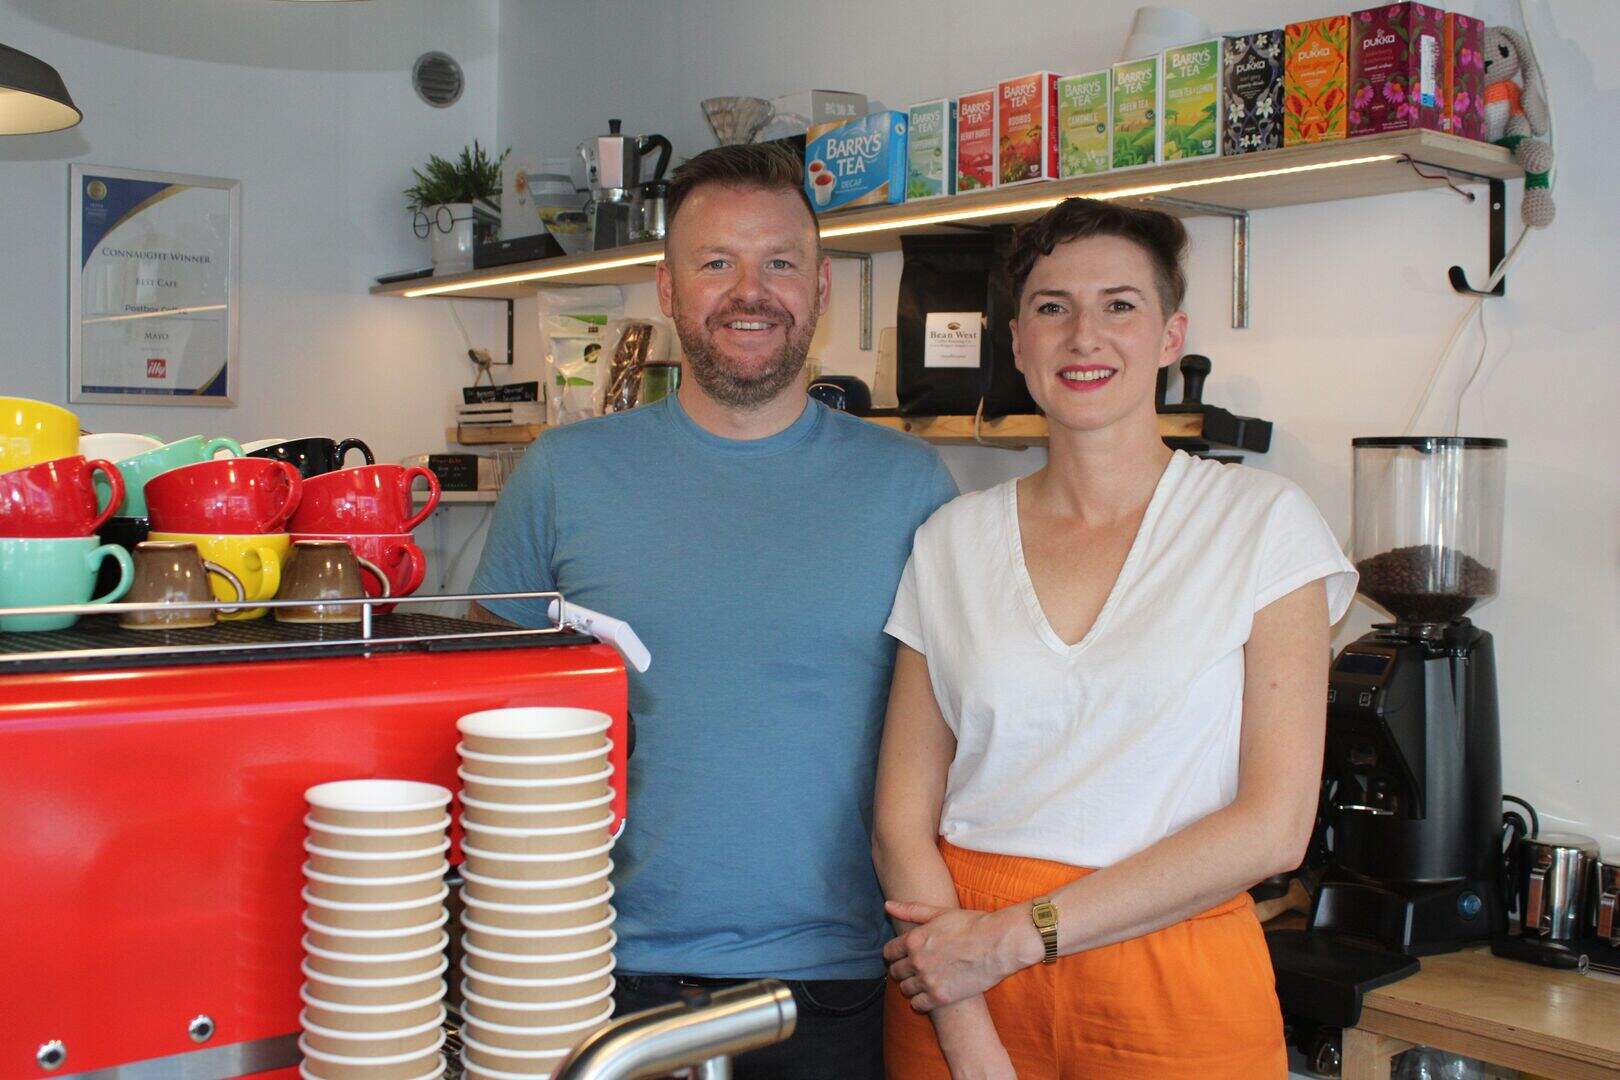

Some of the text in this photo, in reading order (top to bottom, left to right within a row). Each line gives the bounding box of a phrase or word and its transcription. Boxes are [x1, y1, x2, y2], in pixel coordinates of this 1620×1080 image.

[1363, 34, 1395, 50] pukka
[1172, 48, 1211, 68] BARRY'S
[1298, 47, 1330, 62] pukka
[1180, 65, 1200, 78] TEA
[1236, 60, 1266, 75] pukka
[1118, 68, 1152, 86] BARRY'S
[1004, 81, 1036, 99] BARRY'S
[1065, 80, 1101, 98] BARRY'S
[1125, 83, 1144, 95] TEA
[961, 101, 991, 116] BARRY'S
[1010, 97, 1028, 108] TEA
[1072, 95, 1092, 108] TEA
[967, 113, 983, 125] TEA
[918, 122, 934, 134] TEA
[826, 131, 881, 160] BARRY'S
[836, 156, 866, 176] TEA
[841, 178, 862, 189] DECAF
[102, 248, 211, 264] CONNAUGHT WINNER
[144, 332, 169, 340] MAYO
[930, 331, 977, 339] Bean West
[148, 361, 167, 375] illy
